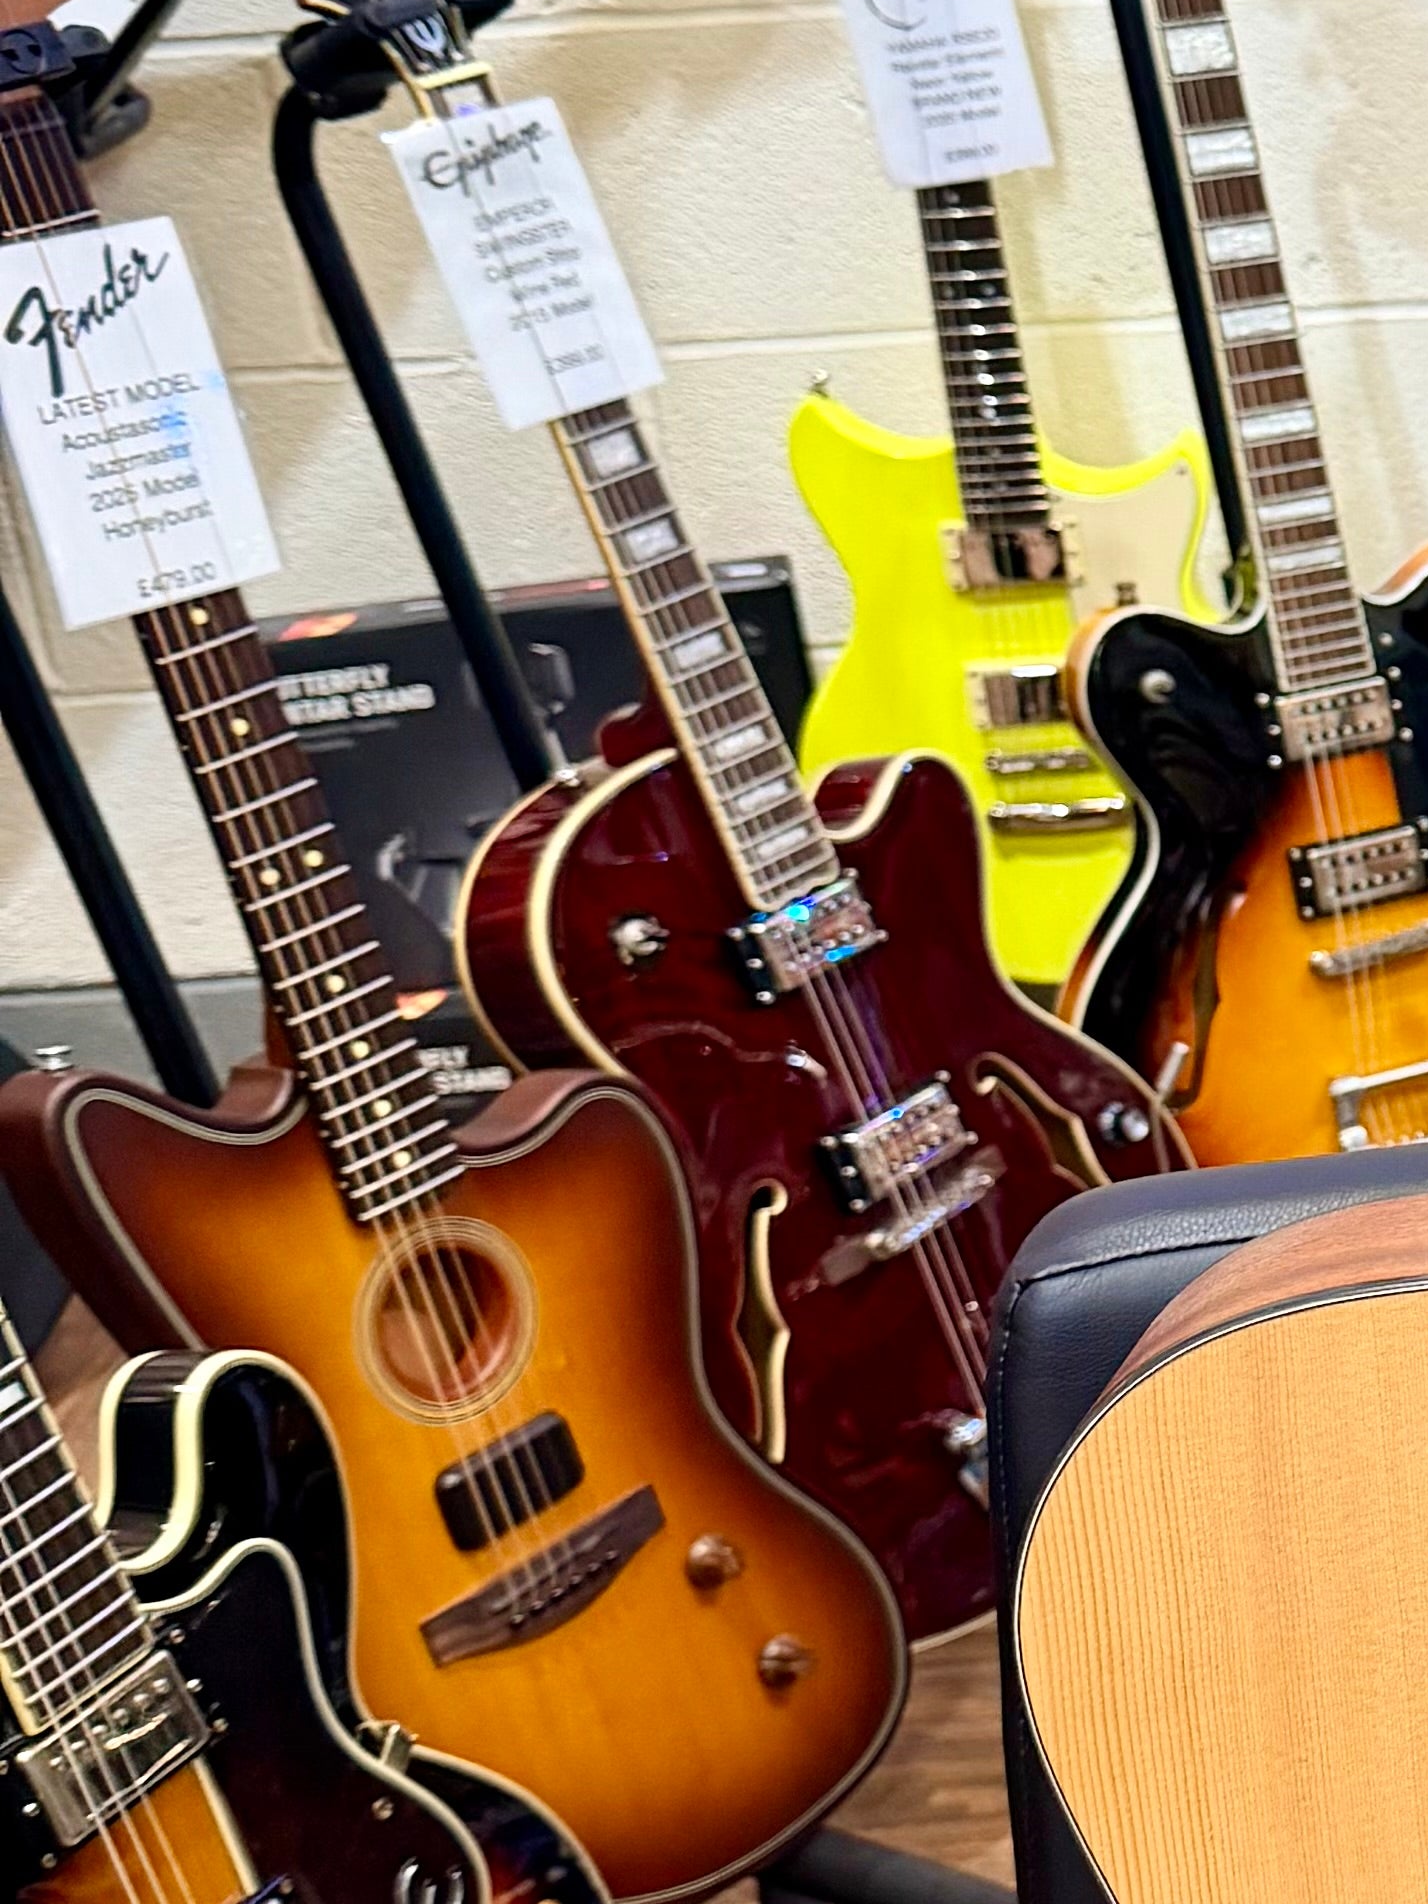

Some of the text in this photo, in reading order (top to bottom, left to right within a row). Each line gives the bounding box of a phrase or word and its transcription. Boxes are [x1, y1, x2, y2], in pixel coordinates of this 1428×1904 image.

[3, 244, 169, 398] Fender
[37, 373, 201, 425] LATEST MODEL
[144, 467, 200, 499] Model
[102, 500, 214, 542] Honeyburst
[352, 683, 435, 717] STAND
